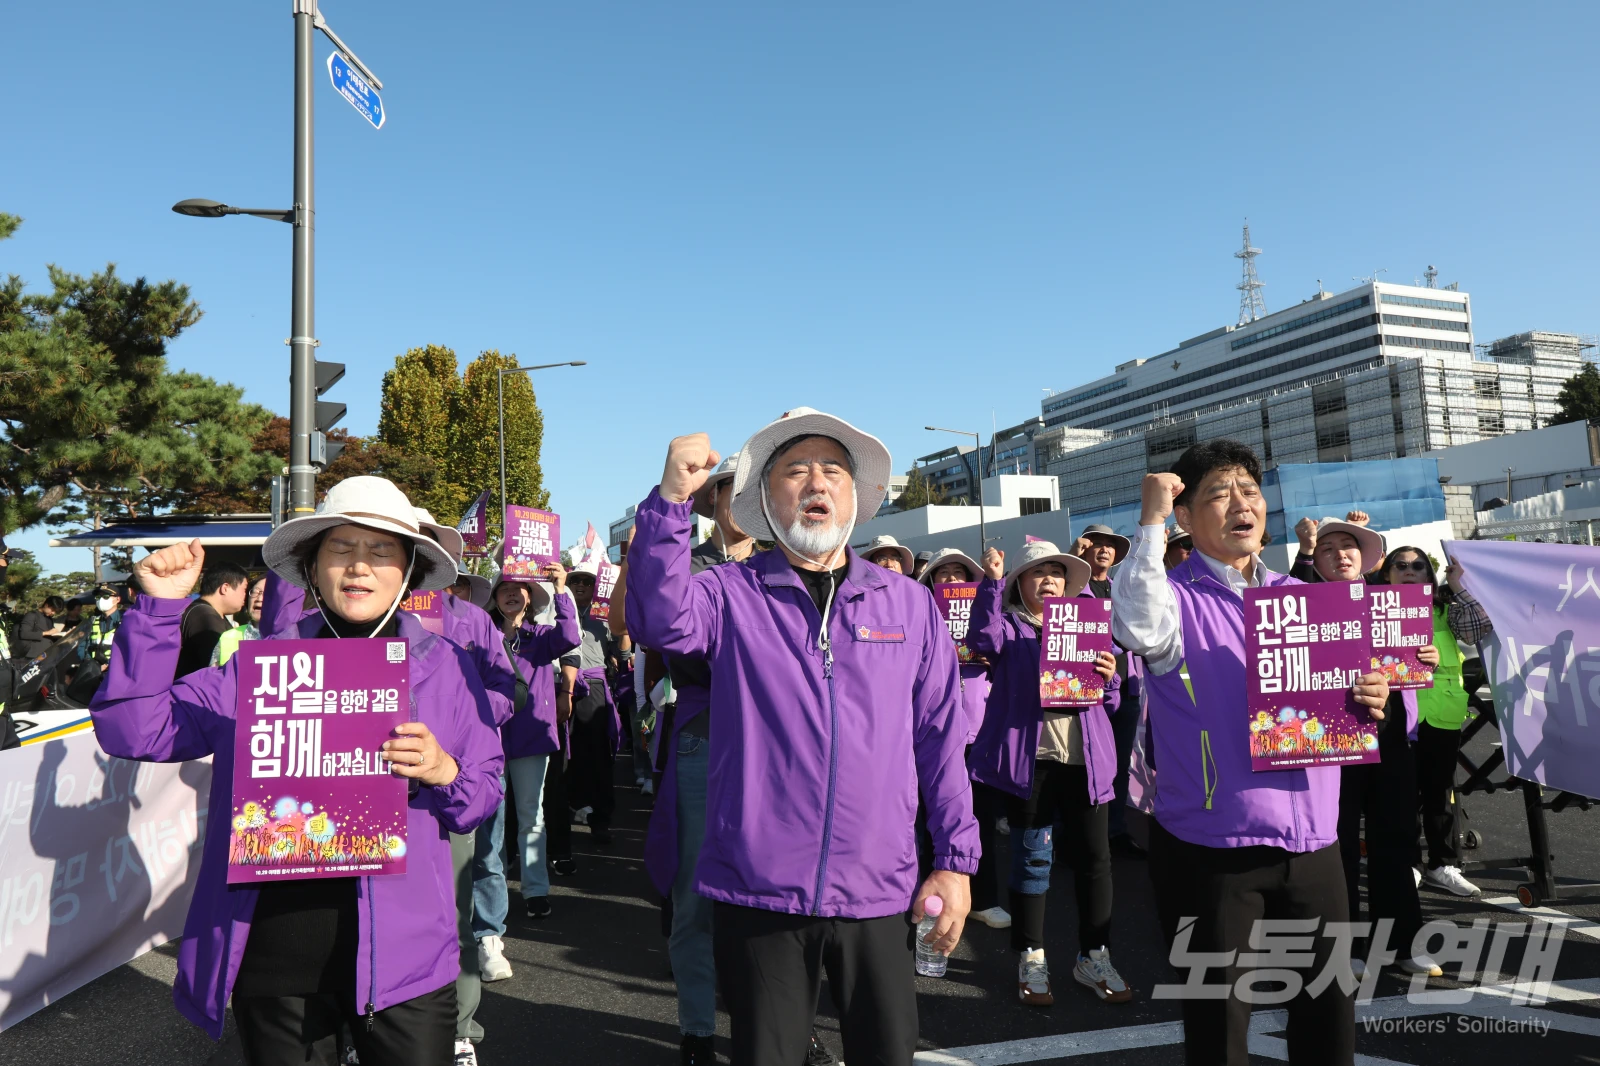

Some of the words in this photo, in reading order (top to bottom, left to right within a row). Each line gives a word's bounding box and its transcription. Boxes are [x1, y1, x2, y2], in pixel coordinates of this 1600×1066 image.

[518, 520, 550, 540] 진상을
[512, 536, 554, 557] 규명하라
[942, 588, 960, 598] 10.29
[1370, 590, 1406, 620] 진실을
[1406, 606, 1418, 618] 향한
[1418, 606, 1430, 618] 걸음
[948, 600, 974, 620] 진상
[1048, 603, 1084, 634] 진실을
[1084, 622, 1096, 634] 향한
[1098, 622, 1108, 634] 걸음
[1254, 594, 1318, 646] 진실을
[1320, 623, 1340, 642] 향한
[1342, 620, 1362, 640] 걸음
[253, 652, 338, 715] 진실을
[341, 689, 368, 714] 향한
[372, 688, 398, 714] 걸음
